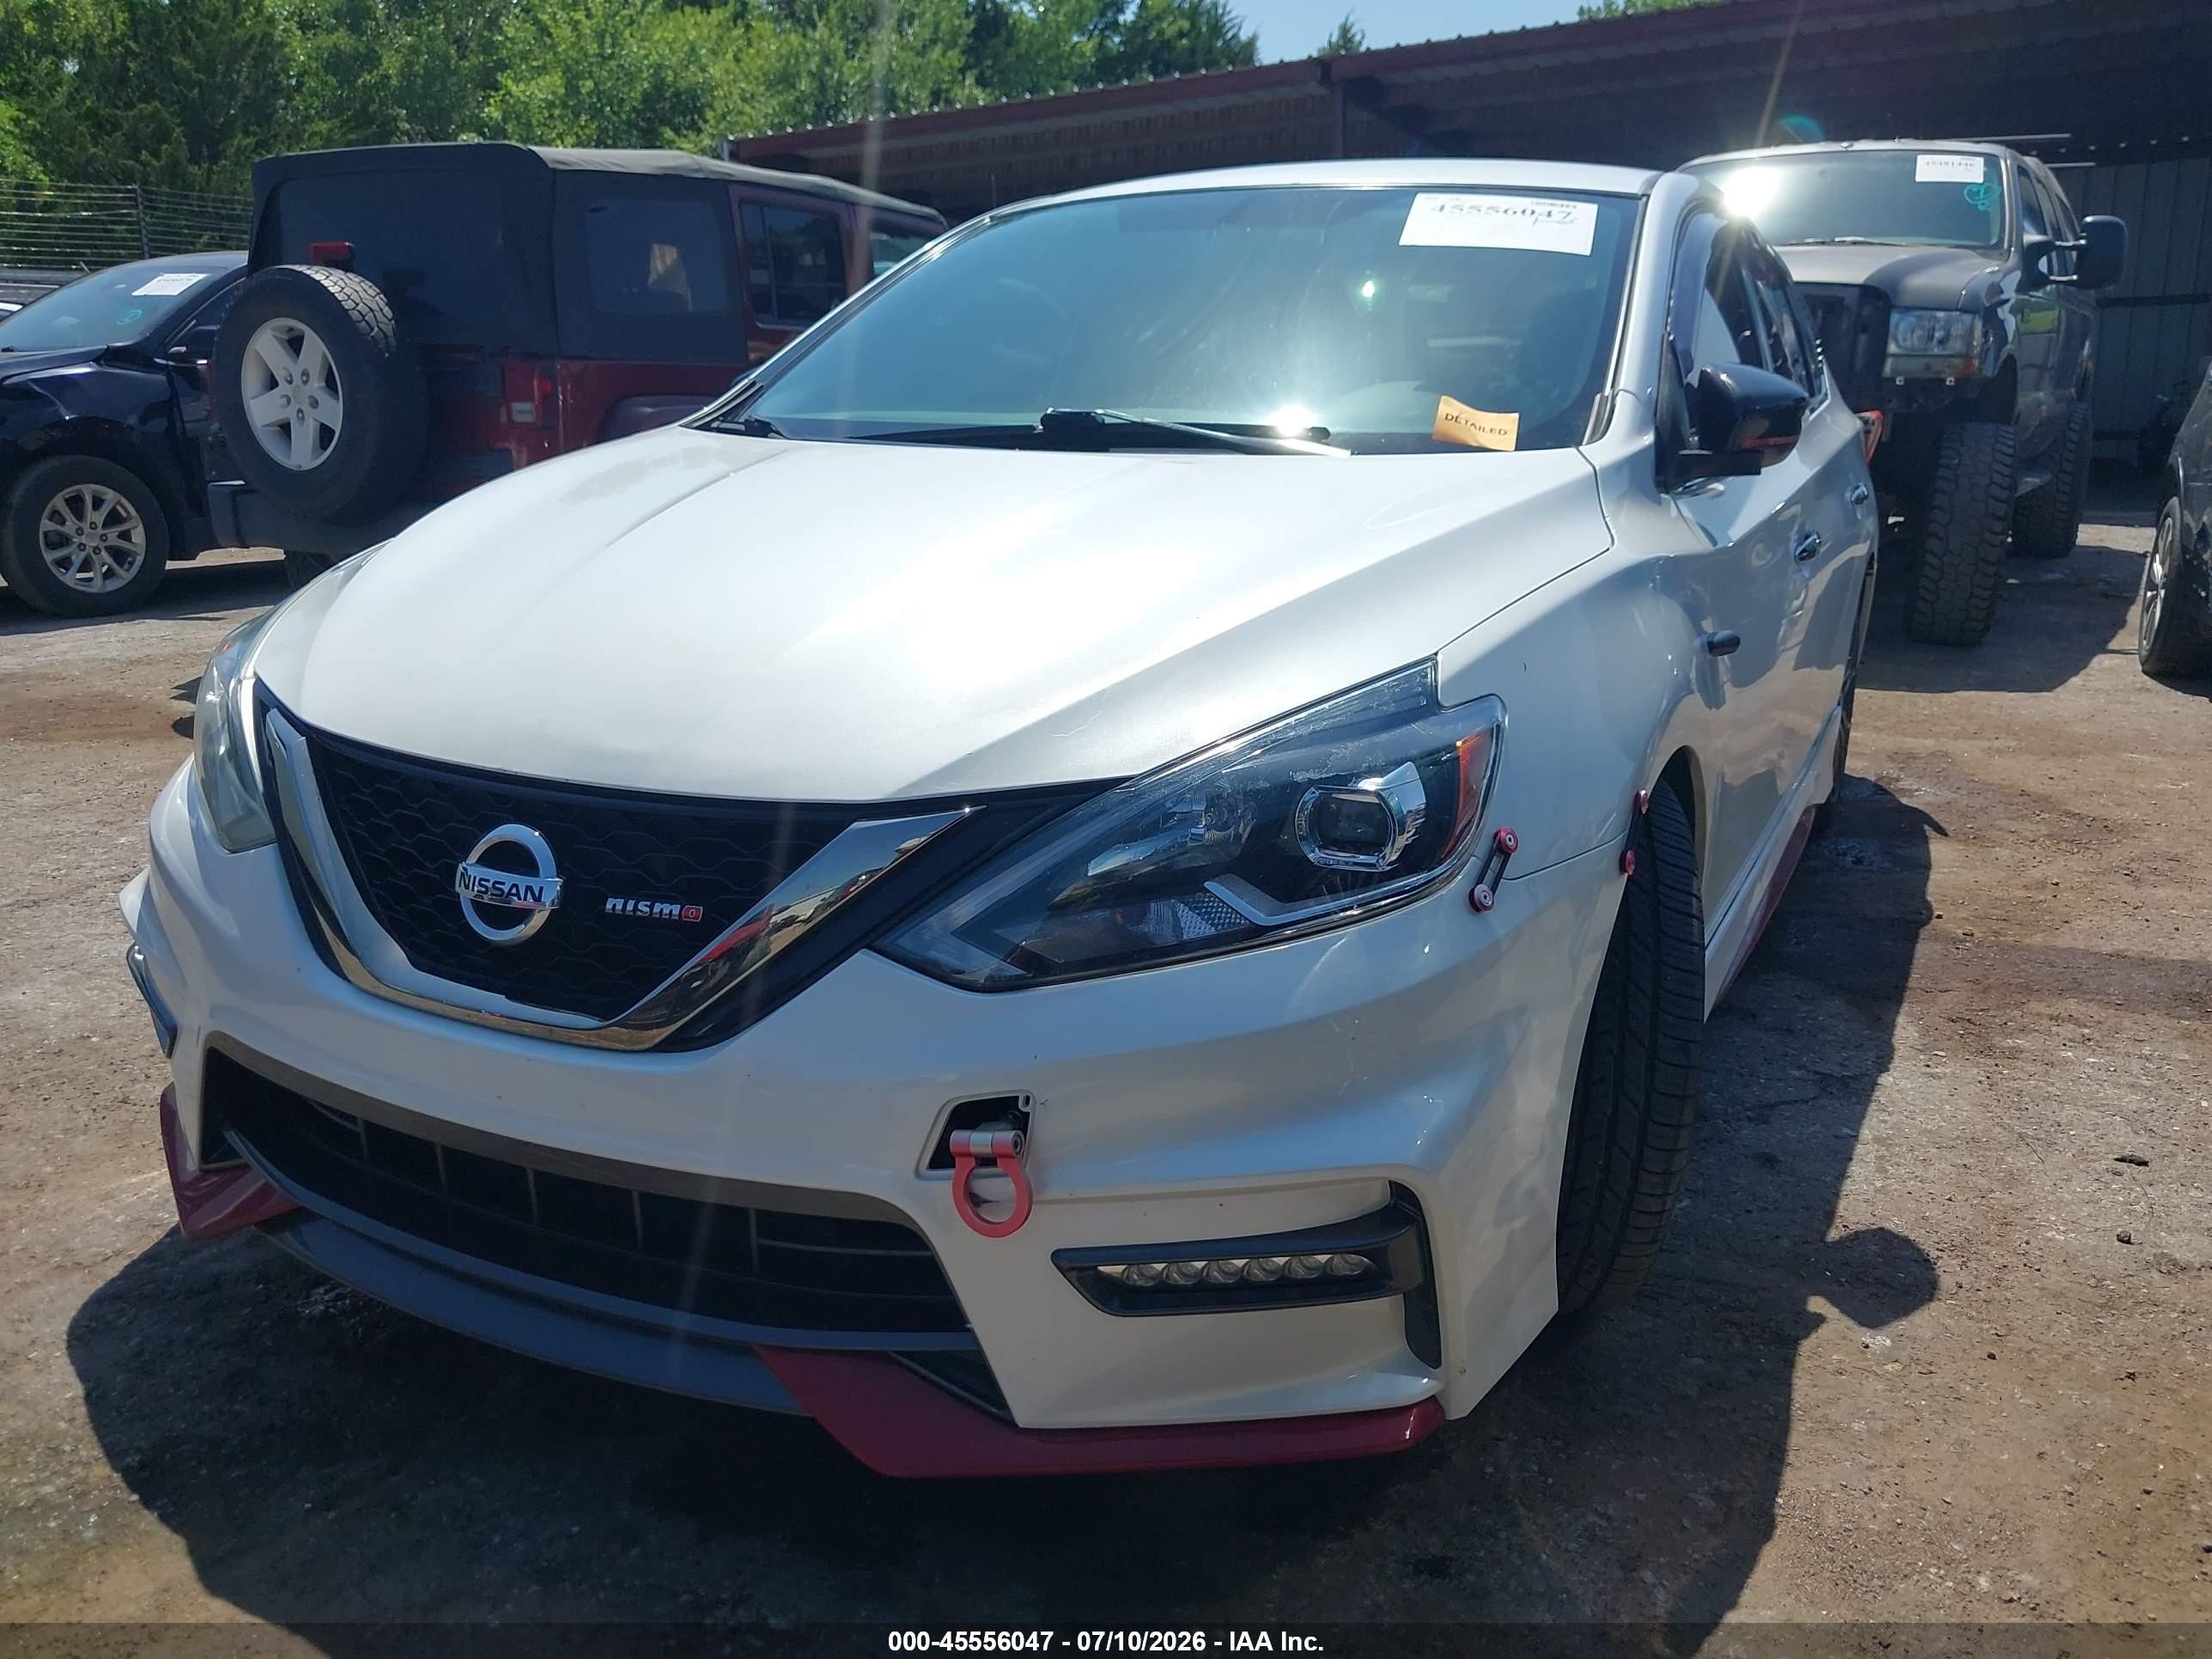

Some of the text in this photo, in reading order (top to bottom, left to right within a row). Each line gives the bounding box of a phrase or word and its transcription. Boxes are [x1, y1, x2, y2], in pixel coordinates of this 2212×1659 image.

[1431, 204, 1572, 220] 45556047
[1444, 413, 1508, 436] DETAILED
[458, 866, 544, 903] NISSAN
